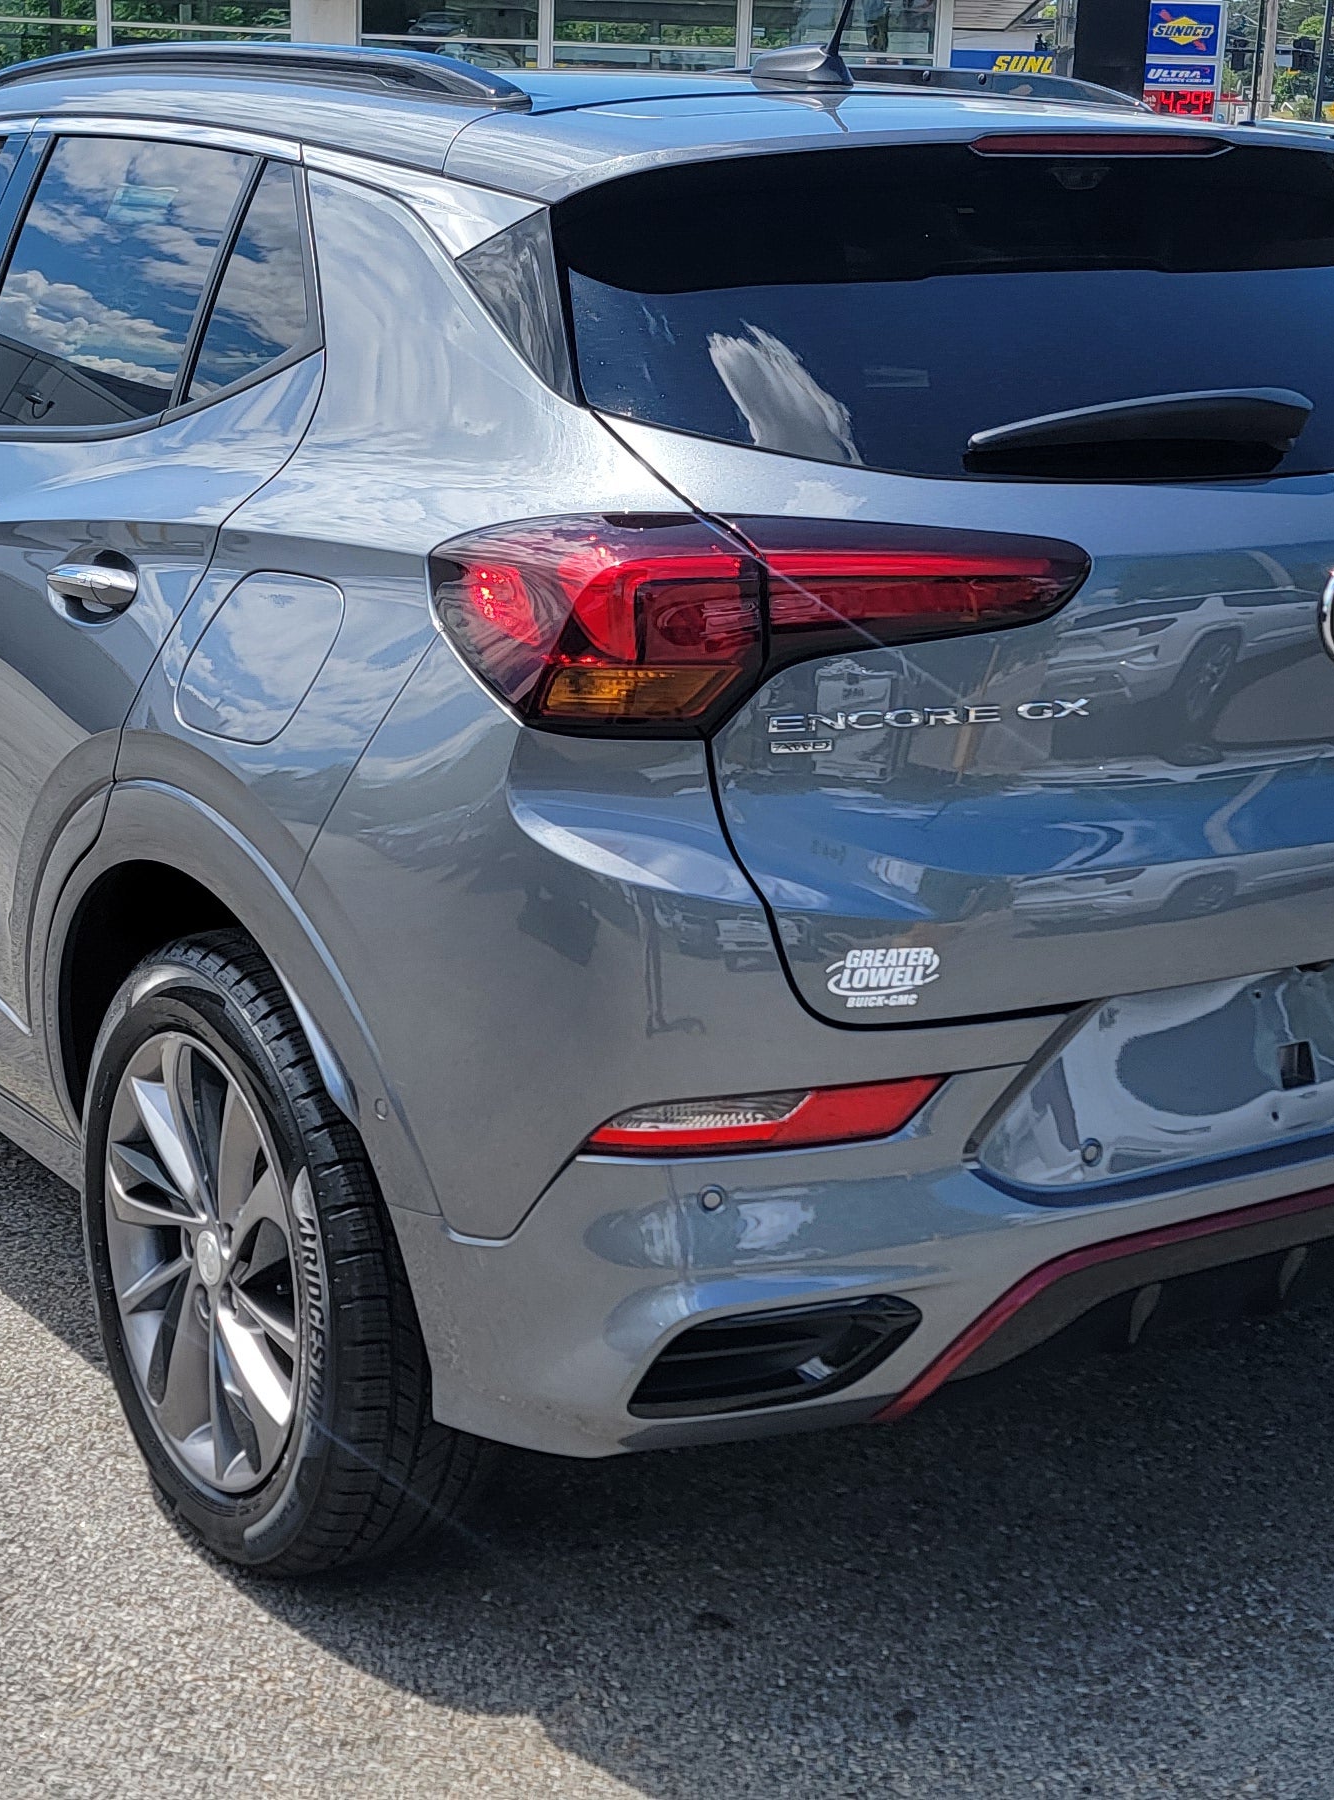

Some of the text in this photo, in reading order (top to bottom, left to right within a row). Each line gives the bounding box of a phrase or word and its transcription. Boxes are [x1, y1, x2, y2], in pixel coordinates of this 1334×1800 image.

[1154, 25, 1213, 37] SUNOCO
[1147, 68, 1201, 79] ULTRA
[768, 698, 1091, 734] ENCORE GX
[770, 739, 832, 753] AWD
[845, 946, 935, 968] GREATER
[839, 966, 926, 989] LOWELL
